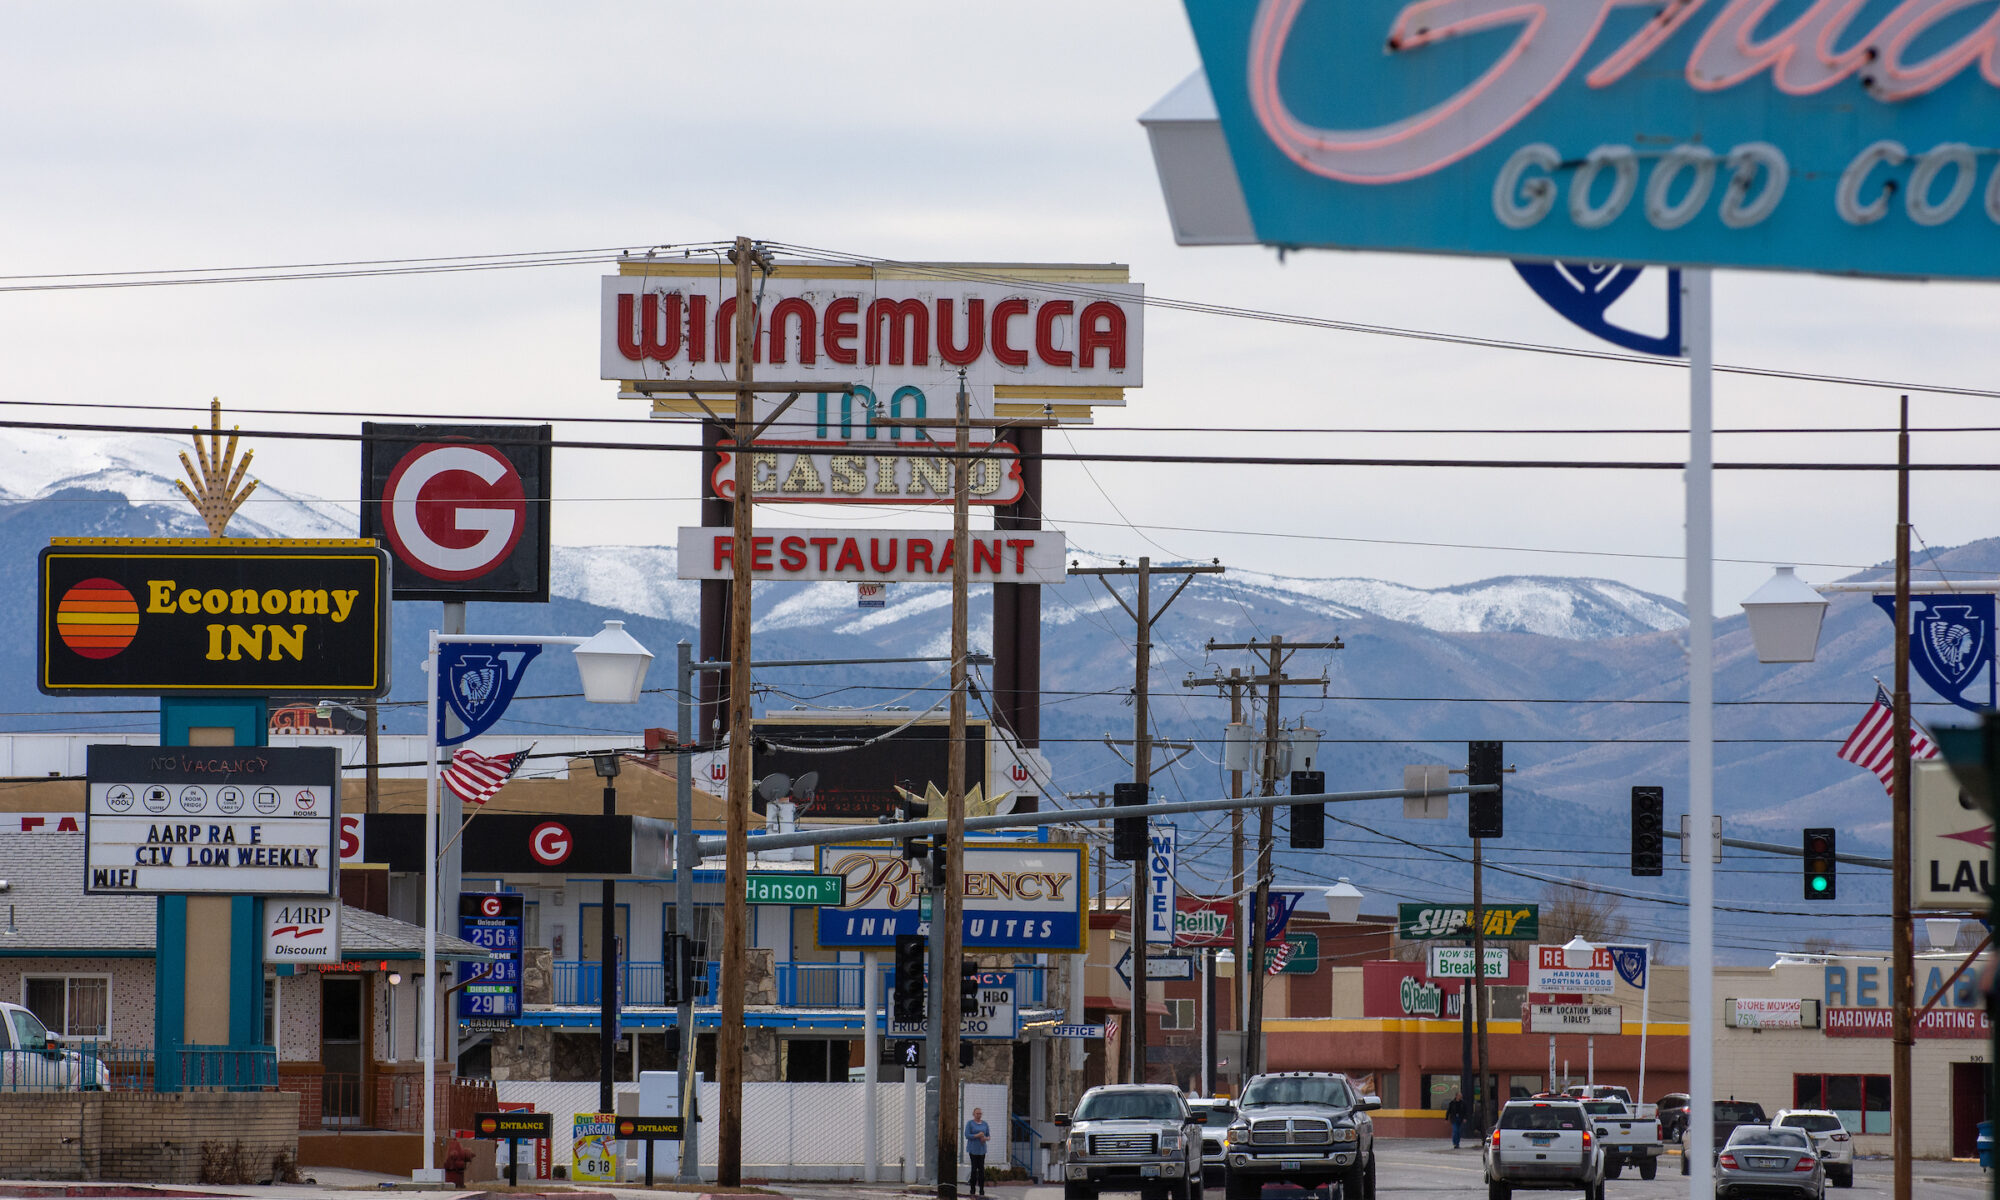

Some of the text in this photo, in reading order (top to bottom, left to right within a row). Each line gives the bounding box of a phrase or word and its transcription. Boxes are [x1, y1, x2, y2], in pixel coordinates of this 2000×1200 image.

[1491, 141, 2000, 230] GOOD CO
[617, 293, 1127, 368] WINNEMUCCA
[752, 450, 1002, 495] CASINO
[393, 446, 516, 572] G
[713, 535, 1035, 574] RESTAURANT
[146, 579, 359, 623] Economy
[205, 623, 308, 662] INN
[151, 755, 269, 773] NO VACANCY
[147, 824, 201, 843] AARP
[533, 826, 568, 861] G
[135, 846, 318, 866] CTV LOW WEEKLY
[93, 869, 139, 888] WIFI
[831, 854, 1072, 909] REENCY
[1151, 836, 1171, 932] MOTEL
[745, 879, 837, 901] Hanson St
[275, 906, 331, 924] AARP
[483, 898, 500, 915] G
[846, 918, 1053, 938] INN & UITES
[1175, 912, 1226, 935] Reilly
[1410, 909, 1531, 936] SUBWAY
[472, 928, 506, 946] 256
[275, 945, 327, 955] Discount
[1438, 950, 1503, 959] NOW SEVING
[1543, 950, 1610, 967] RELE
[318, 961, 361, 973] OFFICE
[1439, 959, 1502, 975] Breakast
[983, 991, 1009, 1003] HBO
[1400, 976, 1442, 1018] O'Reilly
[1737, 1001, 1800, 1010] STORE MOVING
[1540, 1006, 1612, 1015] NEW LOCATION INSIDE
[1563, 1015, 1591, 1024] RIDLEYS
[1737, 1013, 1758, 1026] 75%
[1828, 1010, 1893, 1028] HARDWAR
[1917, 1011, 1975, 1029] PORTING
[470, 1019, 510, 1028] GASOLINE
[893, 1020, 988, 1032] FRIDG CRO
[1052, 1026, 1096, 1036] OFFICE
[500, 1121, 544, 1130] ENTRANCE
[594, 1114, 616, 1124] BEST
[637, 1124, 678, 1133] ENTRANCE
